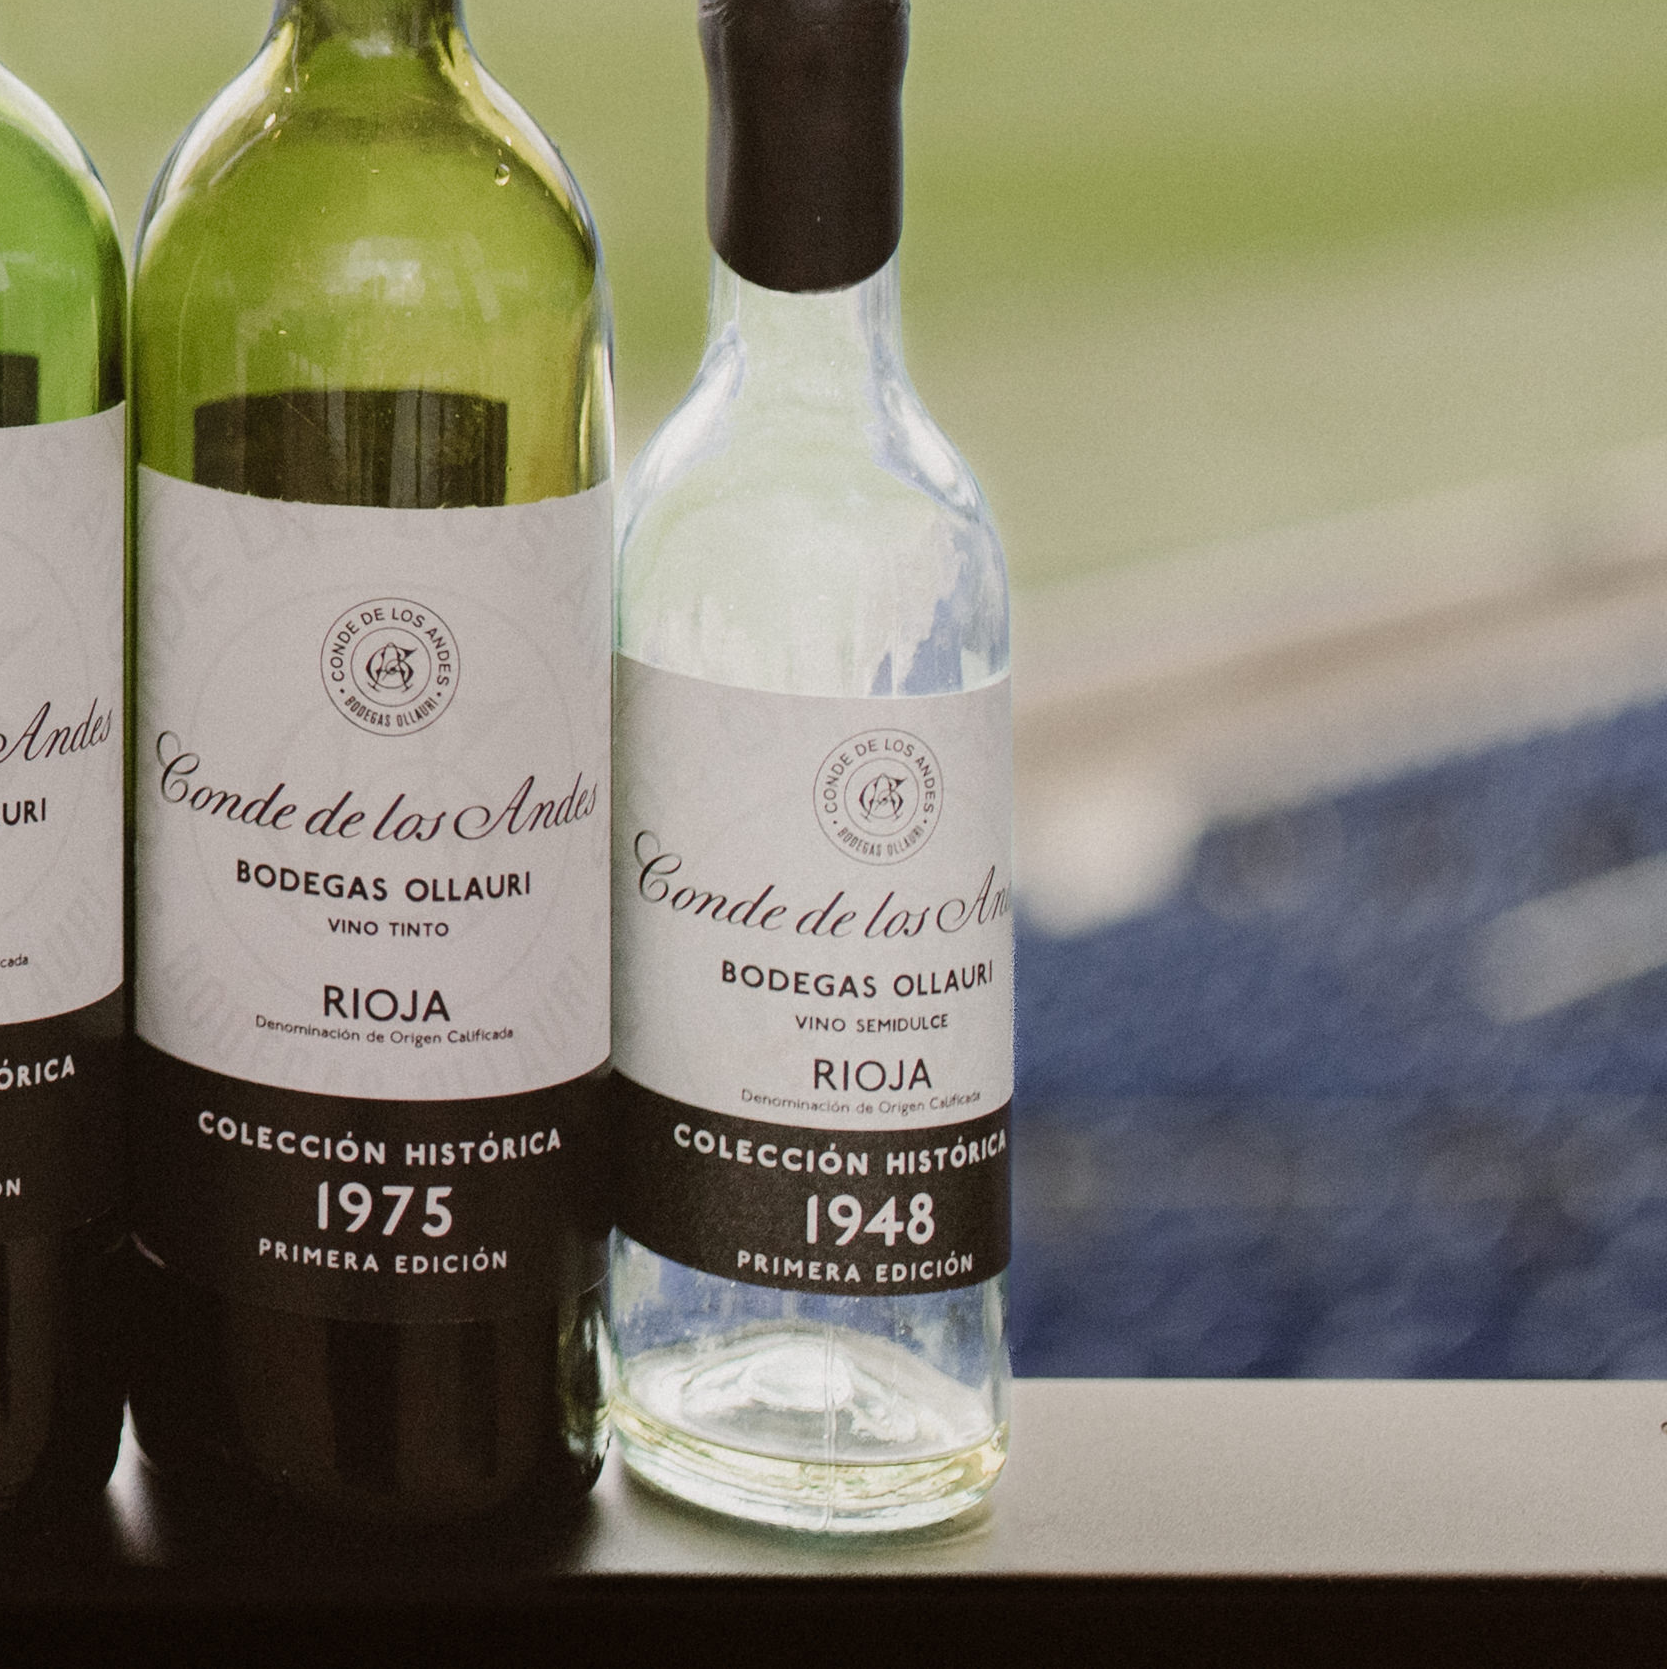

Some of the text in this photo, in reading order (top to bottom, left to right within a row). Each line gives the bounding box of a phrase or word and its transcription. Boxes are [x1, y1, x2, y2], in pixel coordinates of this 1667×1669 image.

[330, 608, 451, 686] CONDE DE LOS ANDES
[344, 696, 438, 727] BODEGAS OLLAURI
[154, 731, 597, 841] Conde de los Andes
[823, 739, 935, 814] CONDE DE LOS ANDES
[237, 859, 530, 902] BODEGAS OLLAURI
[633, 830, 788, 932] Conde
[796, 890, 856, 938] de
[866, 890, 929, 939] los
[328, 918, 449, 937] VINO TINTO
[722, 960, 992, 998] BODEGAS OLLAURI
[324, 985, 450, 1022] RIOJA
[256, 1015, 514, 1048] Denominación de Origen Calificada
[795, 1013, 948, 1033] VINO SEMIDULCE
[814, 1058, 932, 1092] RIOJA
[741, 1088, 851, 1115] Denominación
[855, 1100, 873, 1115] de
[878, 1097, 926, 1116] Origen
[199, 1111, 561, 1166] COLECCIÓN HISTÓRICA
[674, 1124, 1005, 1176] COLECCIÓN HISTÓRICA
[318, 1181, 452, 1237] 1975
[807, 1193, 934, 1246] 1948
[259, 1238, 507, 1274] PRIMERA EDICIÓN
[738, 1250, 972, 1283] PRIMERA EDICIÓN
